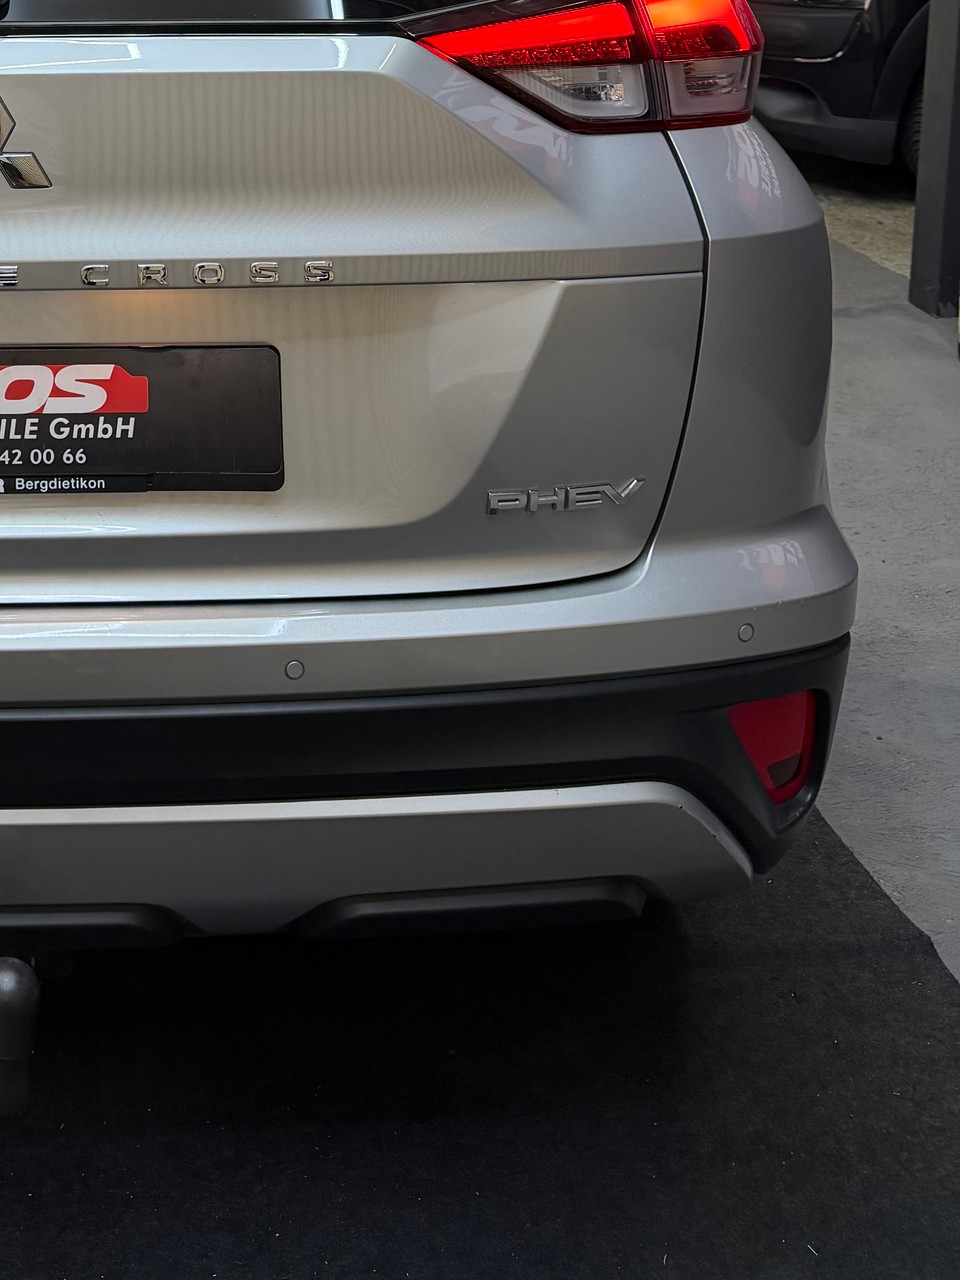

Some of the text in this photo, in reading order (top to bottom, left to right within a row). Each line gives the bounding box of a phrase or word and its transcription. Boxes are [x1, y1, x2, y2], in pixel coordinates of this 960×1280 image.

[81, 261, 336, 287] CROSS
[49, 417, 136, 439] GmbH
[29, 449, 55, 465] 00
[62, 448, 87, 464] 66
[15, 477, 106, 492] Bergdietikon
[486, 477, 646, 516] PHEV
